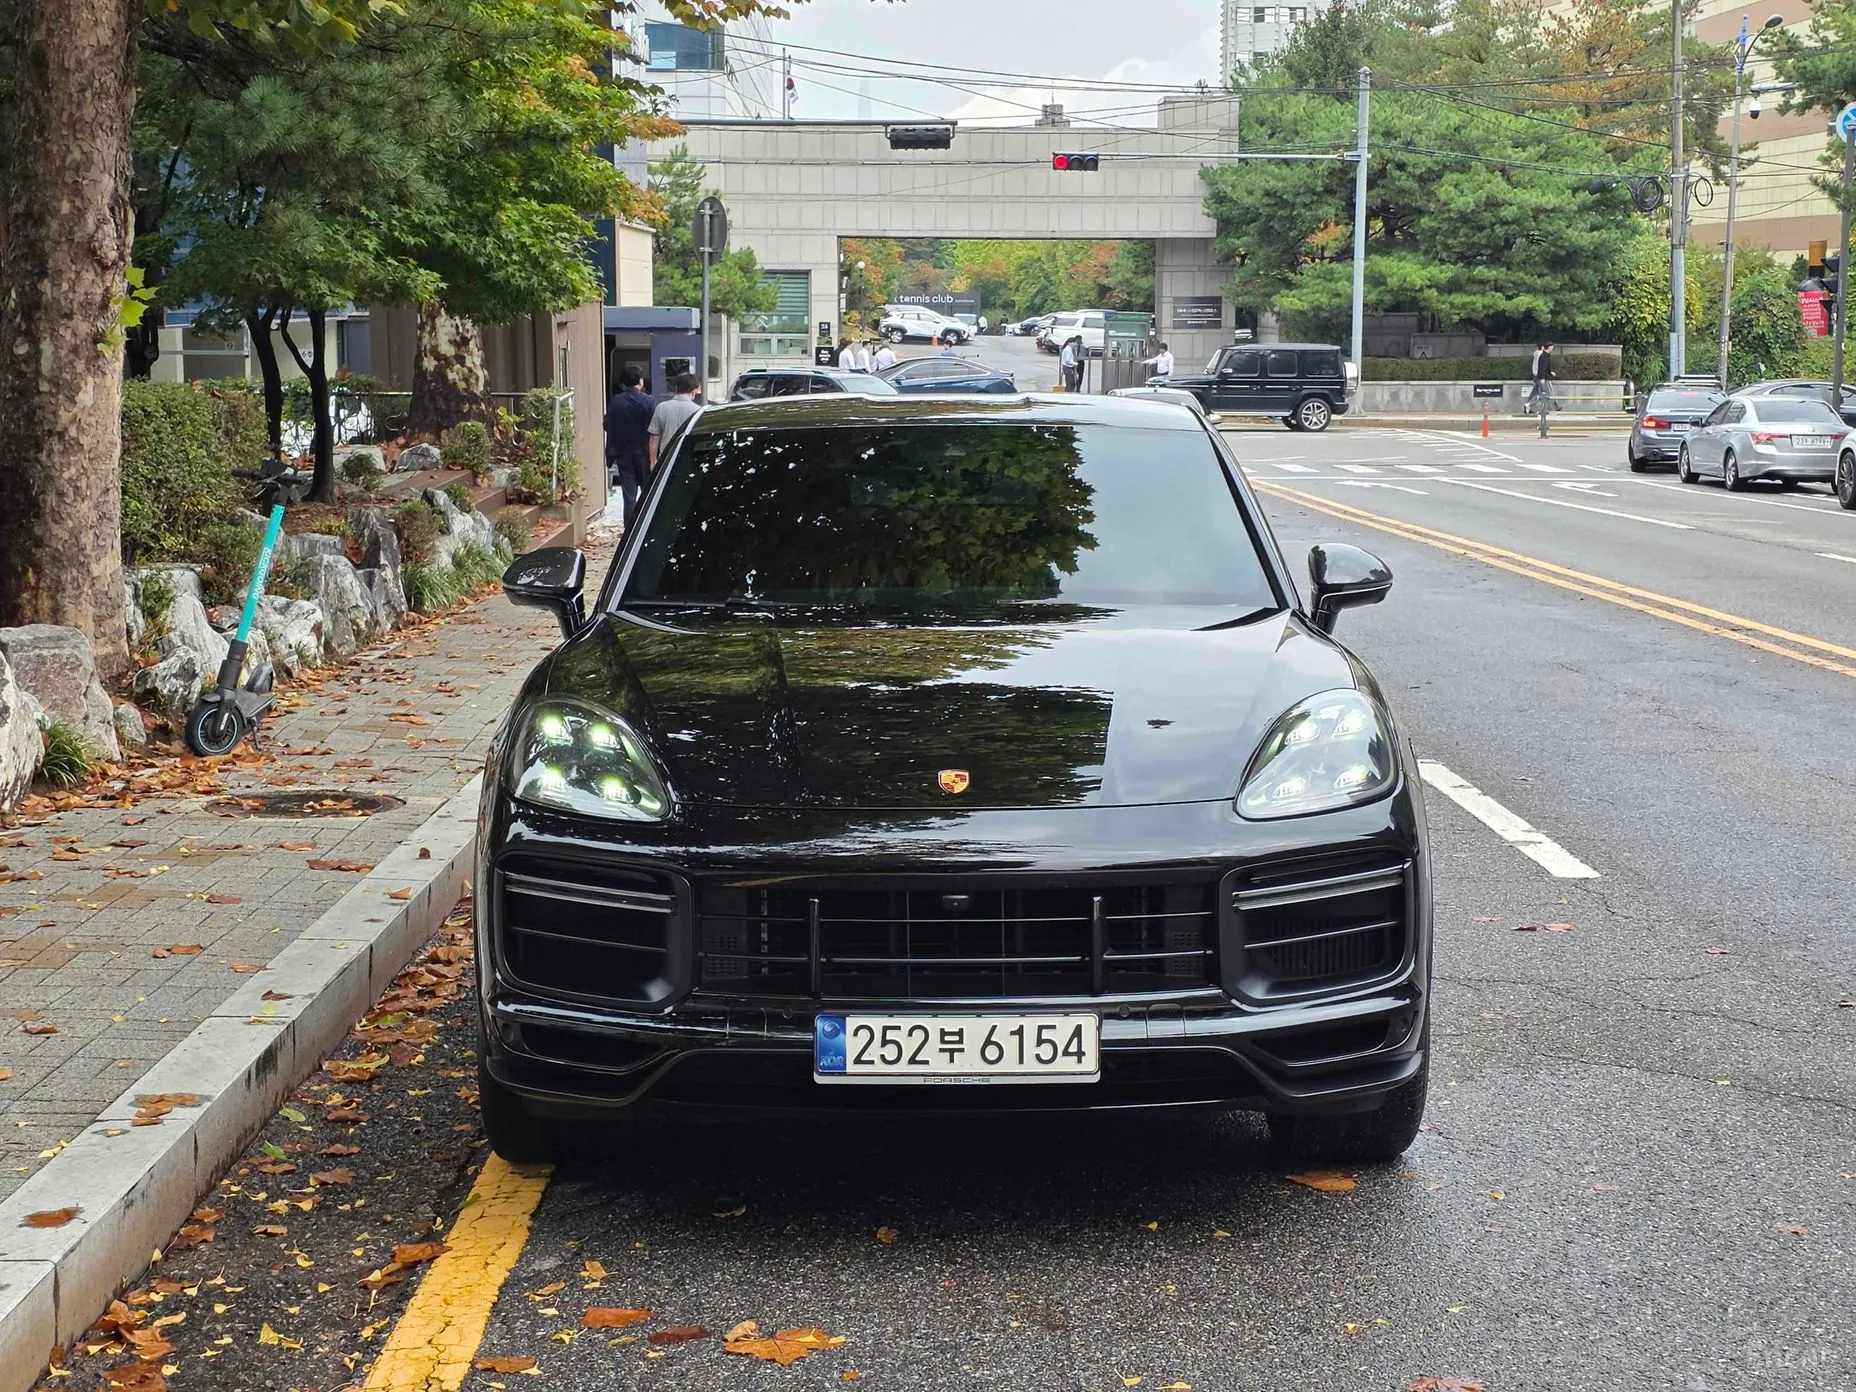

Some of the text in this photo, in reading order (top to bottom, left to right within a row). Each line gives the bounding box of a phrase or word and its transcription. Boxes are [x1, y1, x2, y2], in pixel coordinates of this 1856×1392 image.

[899, 293, 931, 304] tennis
[932, 293, 954, 304] club
[252, 547, 272, 600] KICKGOING
[852, 1024, 1086, 1065] 252부 6154
[819, 1055, 844, 1067] KOR
